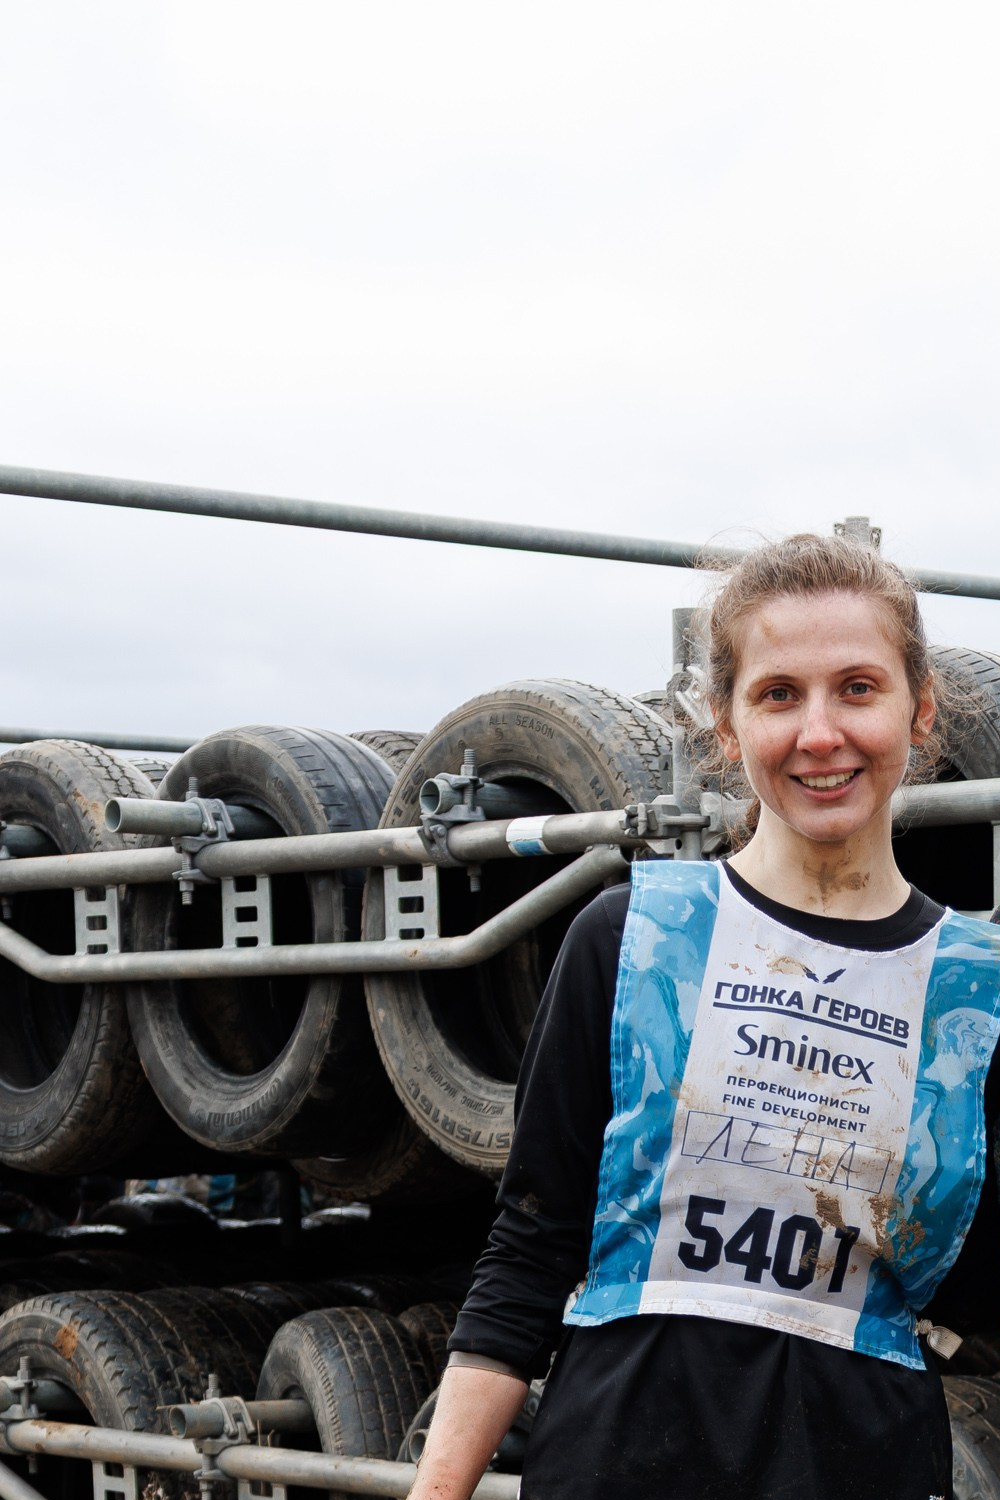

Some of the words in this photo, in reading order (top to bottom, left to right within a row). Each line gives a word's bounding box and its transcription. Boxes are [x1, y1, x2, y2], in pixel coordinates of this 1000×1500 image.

[489, 713, 509, 727] ALL
[516, 713, 555, 740] SEASON
[714, 981, 804, 1011] ГОНКА
[812, 993, 911, 1040] ГЕРОЕВ
[733, 1023, 875, 1085] Sminex
[722, 1093, 756, 1109] FINE
[761, 1101, 868, 1133] DEVELOPMENT
[726, 1075, 871, 1115] ПЕРФЕКЦИОНИСТЫ
[696, 1115, 860, 1191] ЛЕНА
[677, 1194, 861, 1293] 5401
